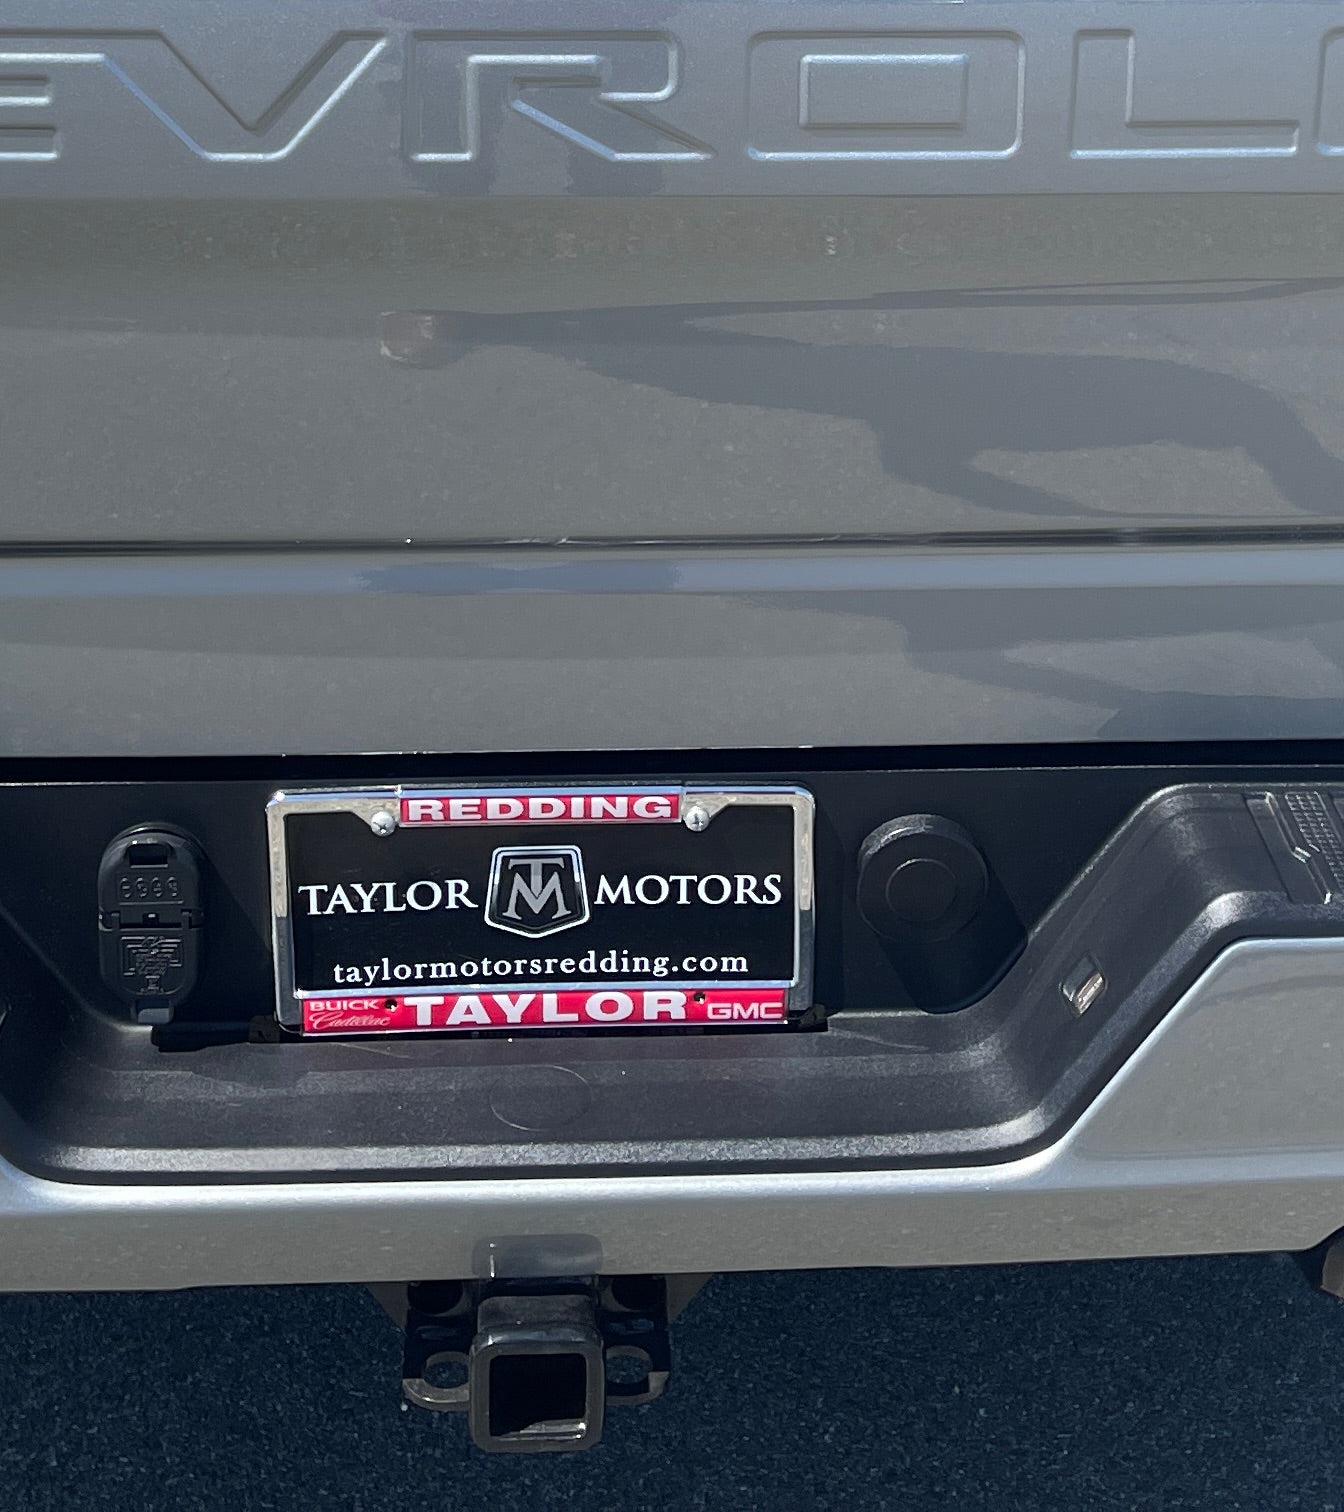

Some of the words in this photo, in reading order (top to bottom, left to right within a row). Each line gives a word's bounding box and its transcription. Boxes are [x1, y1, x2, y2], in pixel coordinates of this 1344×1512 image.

[406, 794, 673, 822] REDDING
[297, 878, 479, 916] TAYLOR
[593, 873, 783, 907] MOTORS
[333, 949, 749, 987] taylormotorsredding.com
[309, 999, 380, 1012] BUICK
[402, 991, 689, 1028] TAYLOR
[706, 1001, 785, 1022] GMC
